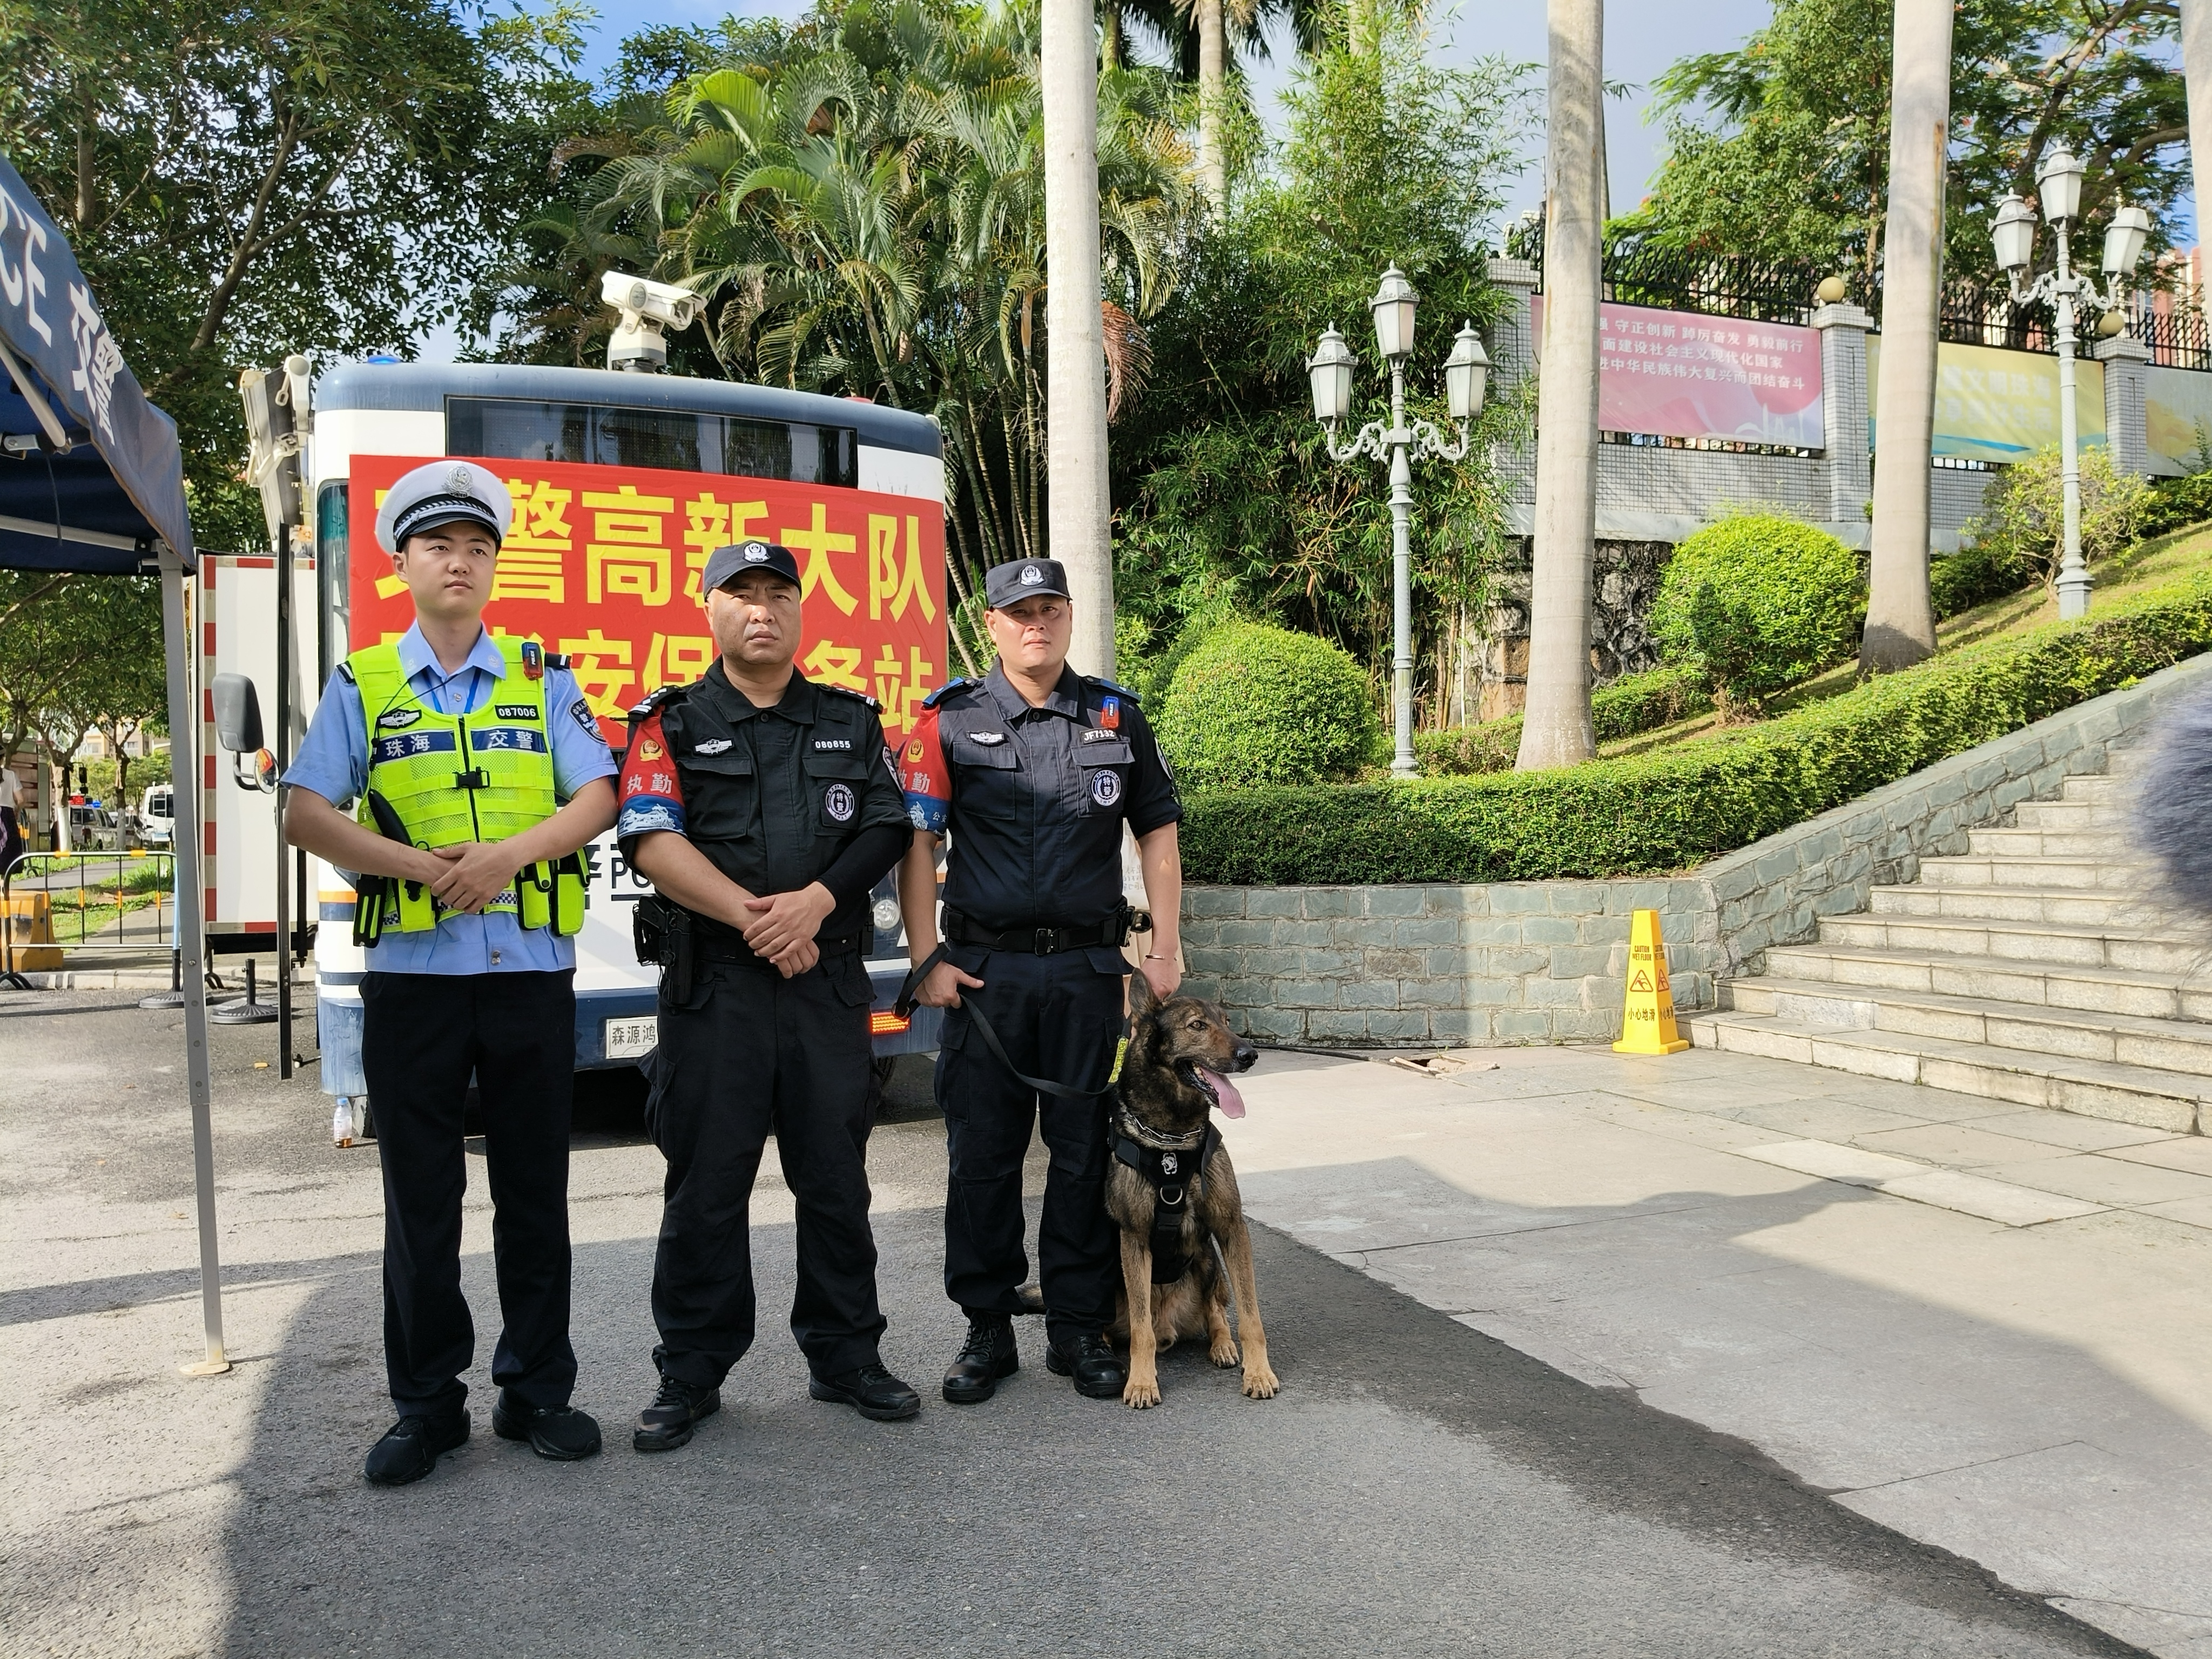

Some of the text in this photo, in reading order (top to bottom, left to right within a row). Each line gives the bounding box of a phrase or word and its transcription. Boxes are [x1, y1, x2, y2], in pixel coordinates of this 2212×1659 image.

[1615, 319, 1676, 339] 守正创新
[1682, 326, 1741, 346] 踔厉奋发
[1747, 334, 1803, 353] 勇毅前行
[1602, 337, 1783, 369] 面建设社会主义现代化国家
[375, 478, 936, 625] 警高新大队
[498, 707, 536, 717] 087006
[385, 730, 534, 757] 珠海 交警
[815, 740, 851, 749] 080855
[1084, 730, 1115, 741] JF7132
[626, 773, 672, 795] 执勤
[932, 811, 947, 823] 公安
[1640, 953, 1652, 961] FLOOR
[1628, 1007, 1656, 1022] 小心地滑
[611, 1024, 656, 1046] 森源鸿
